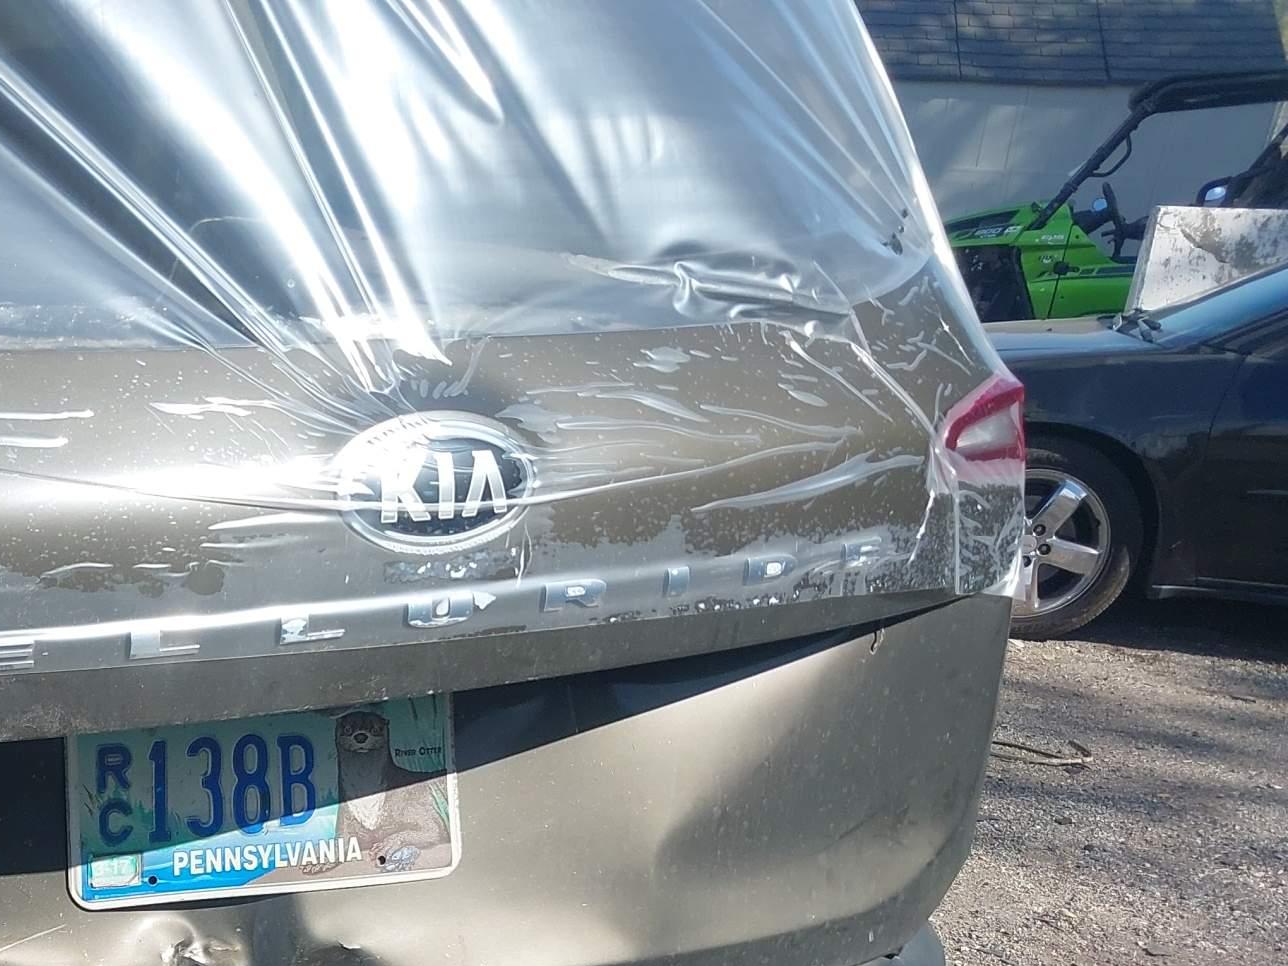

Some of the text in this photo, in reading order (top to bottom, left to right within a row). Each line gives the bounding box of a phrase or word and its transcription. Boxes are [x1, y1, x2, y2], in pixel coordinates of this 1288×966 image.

[380, 449, 508, 524] KIA
[148, 734, 316, 842] 138B
[173, 836, 363, 876] PENNSYLVANIA
